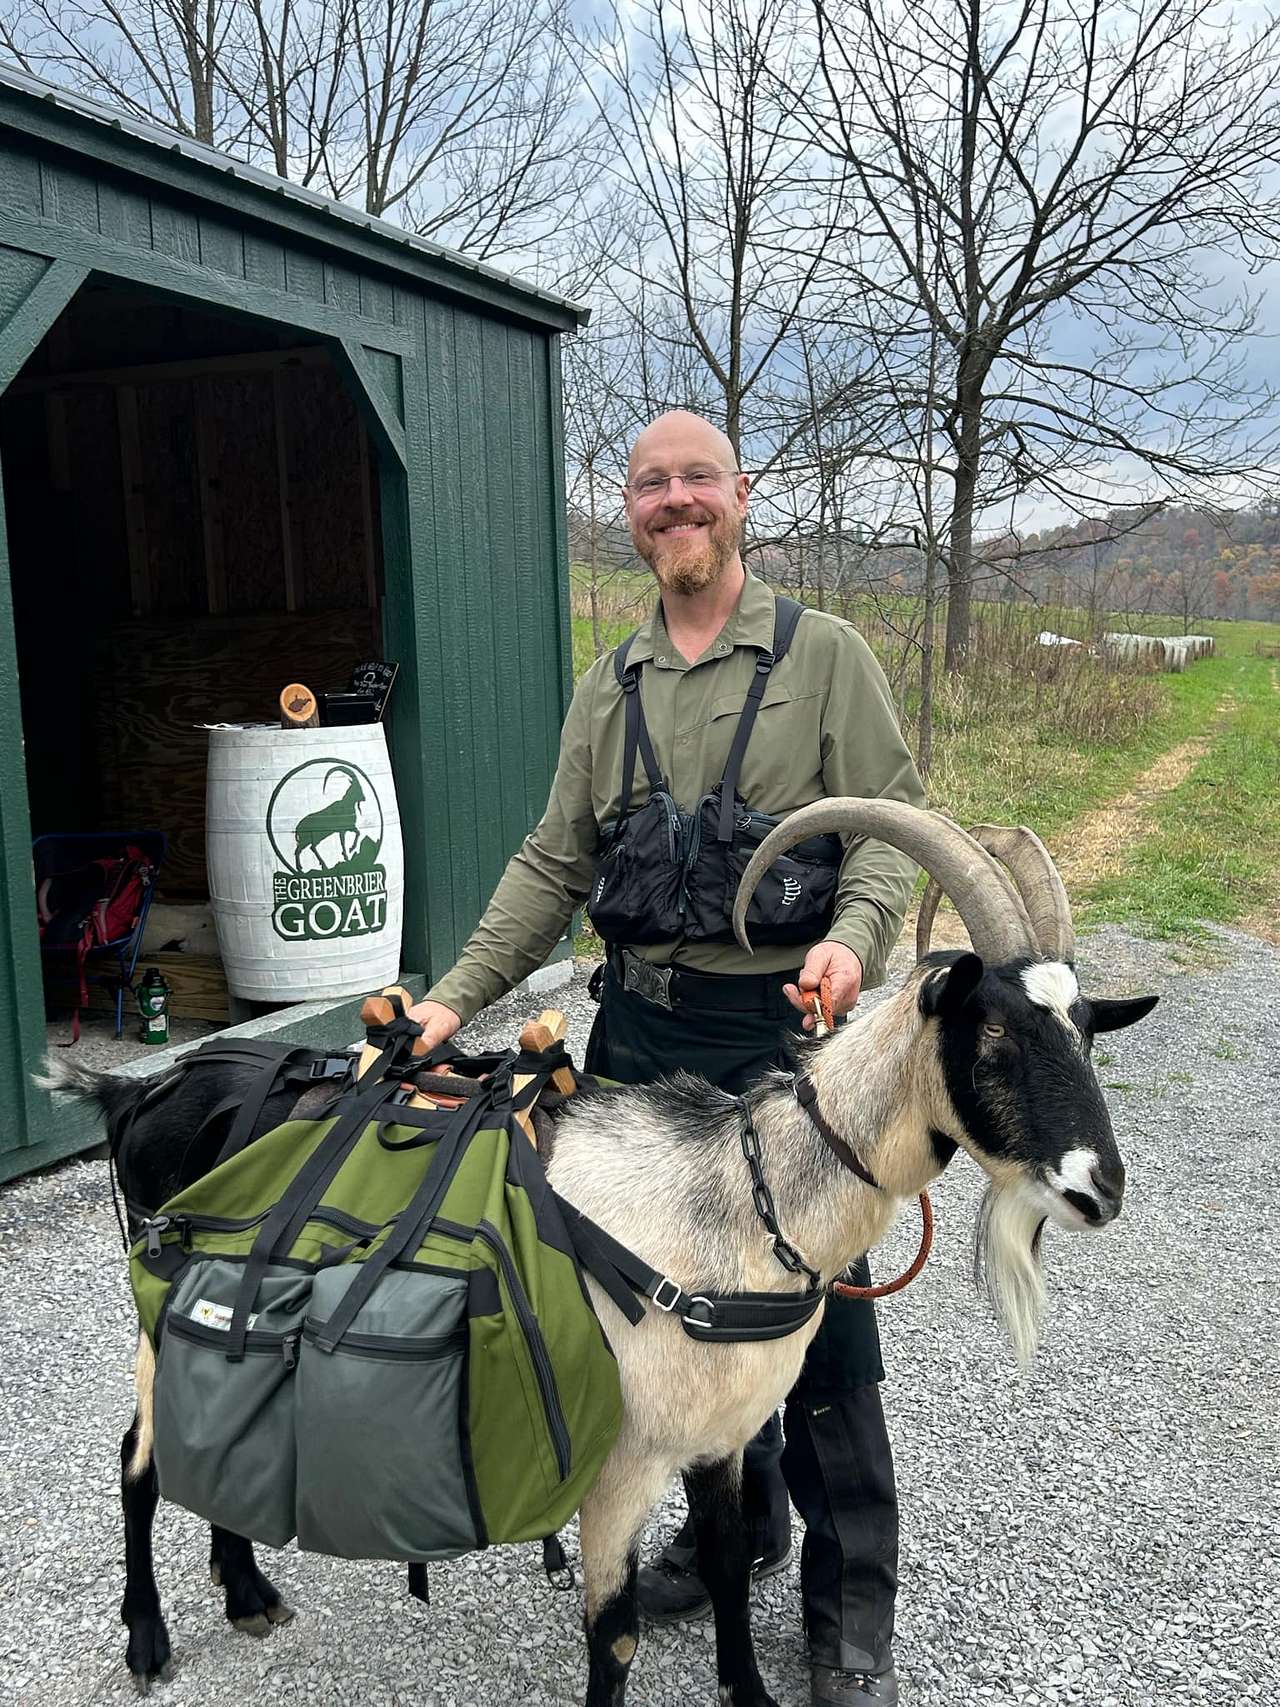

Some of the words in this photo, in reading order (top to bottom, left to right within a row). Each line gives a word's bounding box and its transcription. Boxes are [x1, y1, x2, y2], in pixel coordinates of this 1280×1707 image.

[274, 877, 288, 903] THE
[287, 871, 384, 901] GREENBRIER
[274, 892, 387, 937] GOAT
